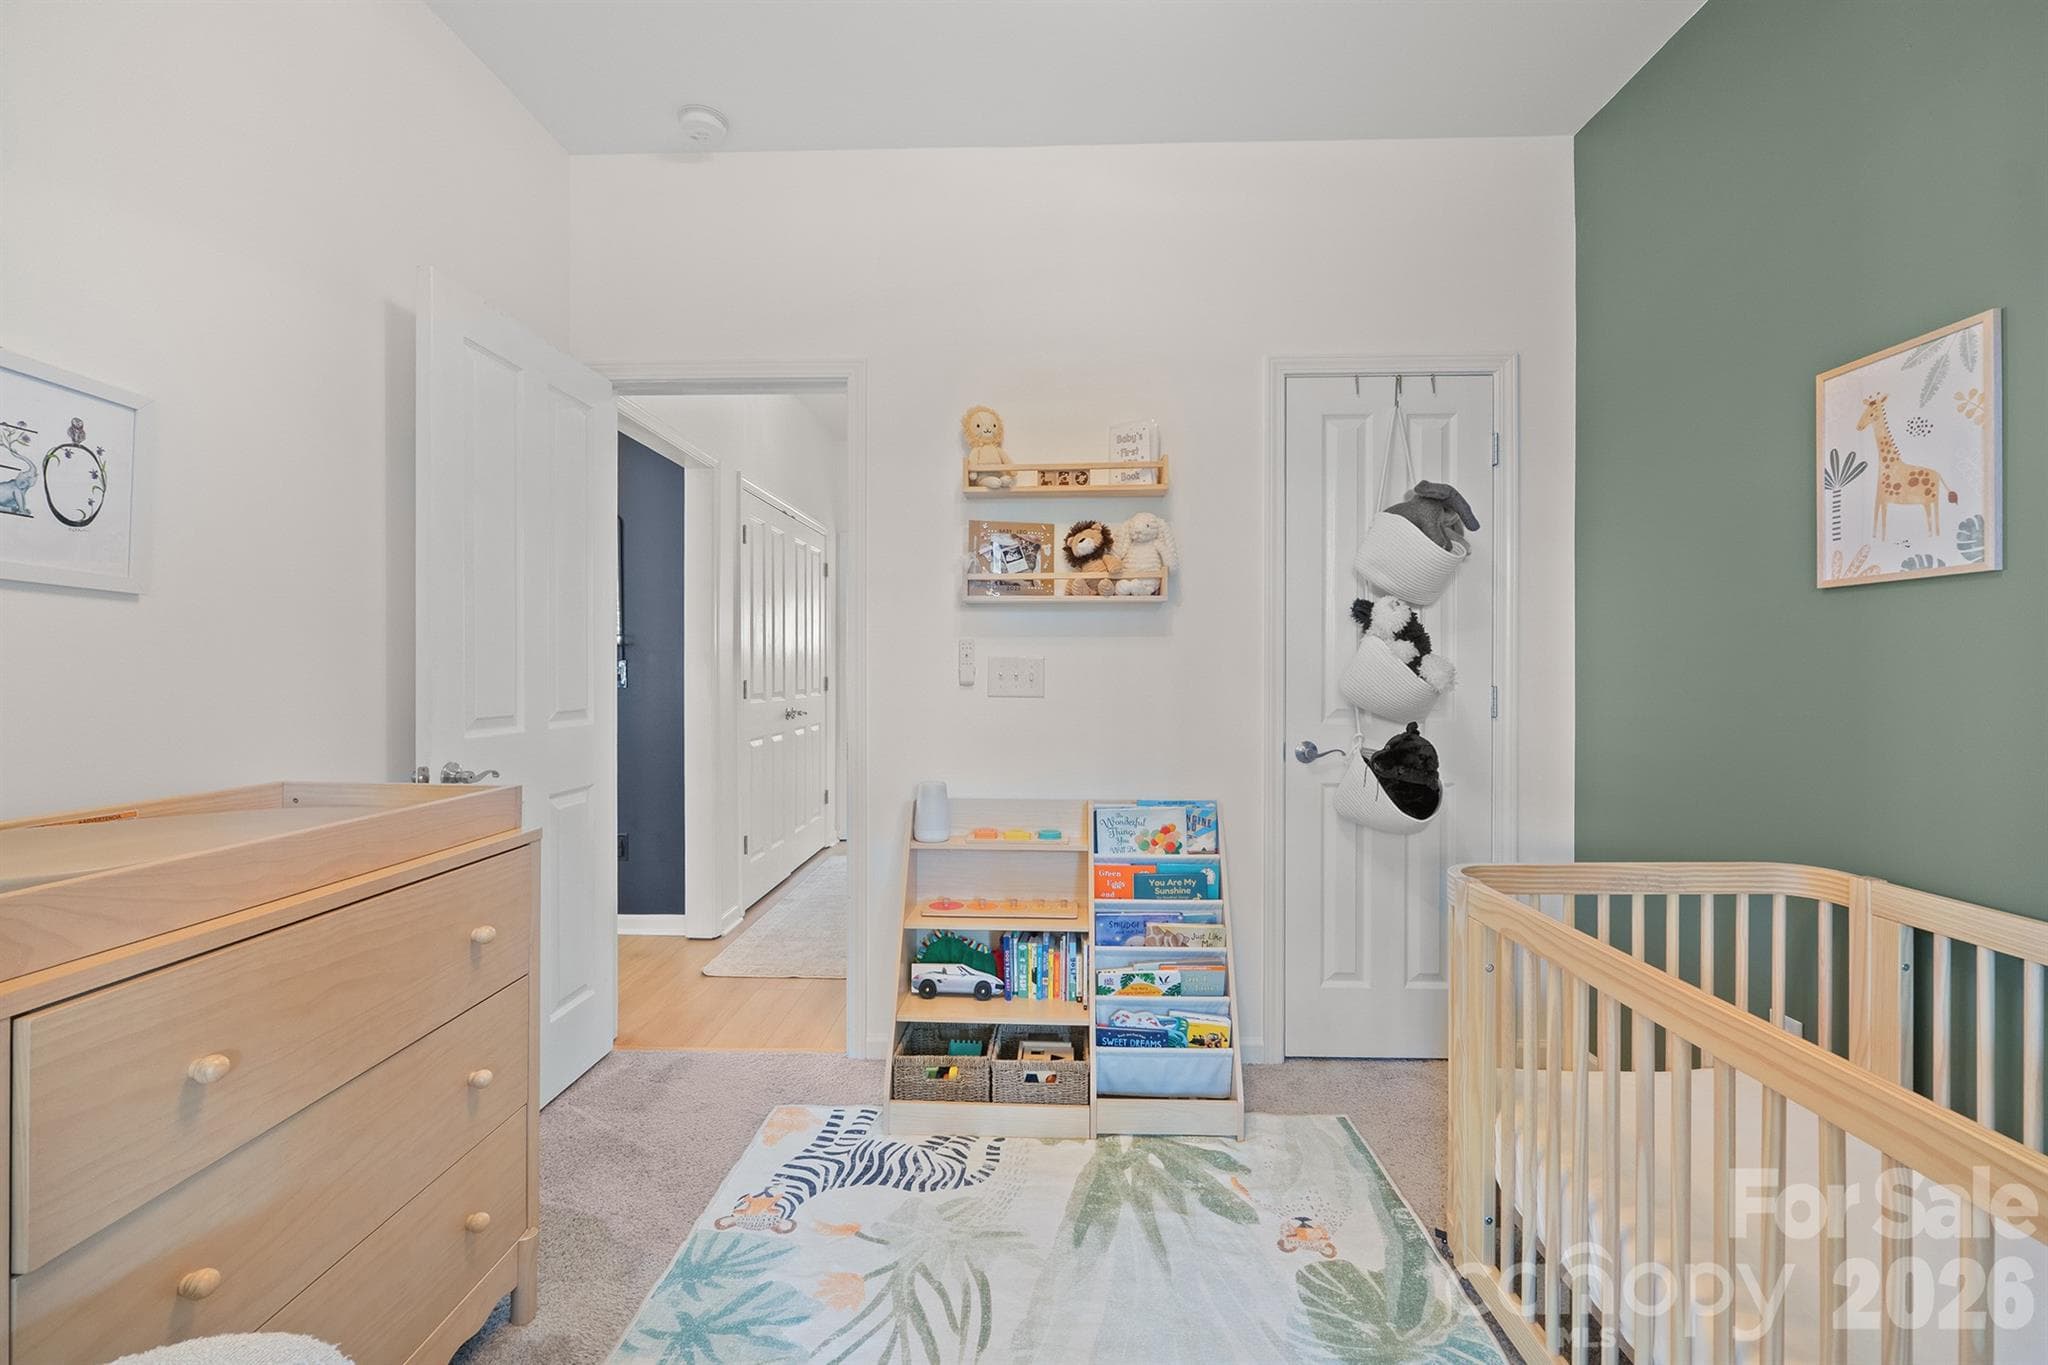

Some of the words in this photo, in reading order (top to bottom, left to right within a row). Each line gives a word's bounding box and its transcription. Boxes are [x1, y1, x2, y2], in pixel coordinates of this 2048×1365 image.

[1116, 432, 1143, 444] Baby's
[1120, 446, 1139, 458] First
[1120, 471, 1140, 481] Book
[1100, 815, 1146, 829] Wonderful
[1109, 828, 1136, 839] Things
[1148, 879, 1166, 887] You
[1167, 879, 1182, 887] Are
[1184, 879, 1197, 888] My
[1154, 887, 1192, 895] Sunshine
[1191, 932, 1206, 941] Just
[1102, 1037, 1128, 1047] SWEET
[1130, 1039, 1162, 1048] DREAMS
